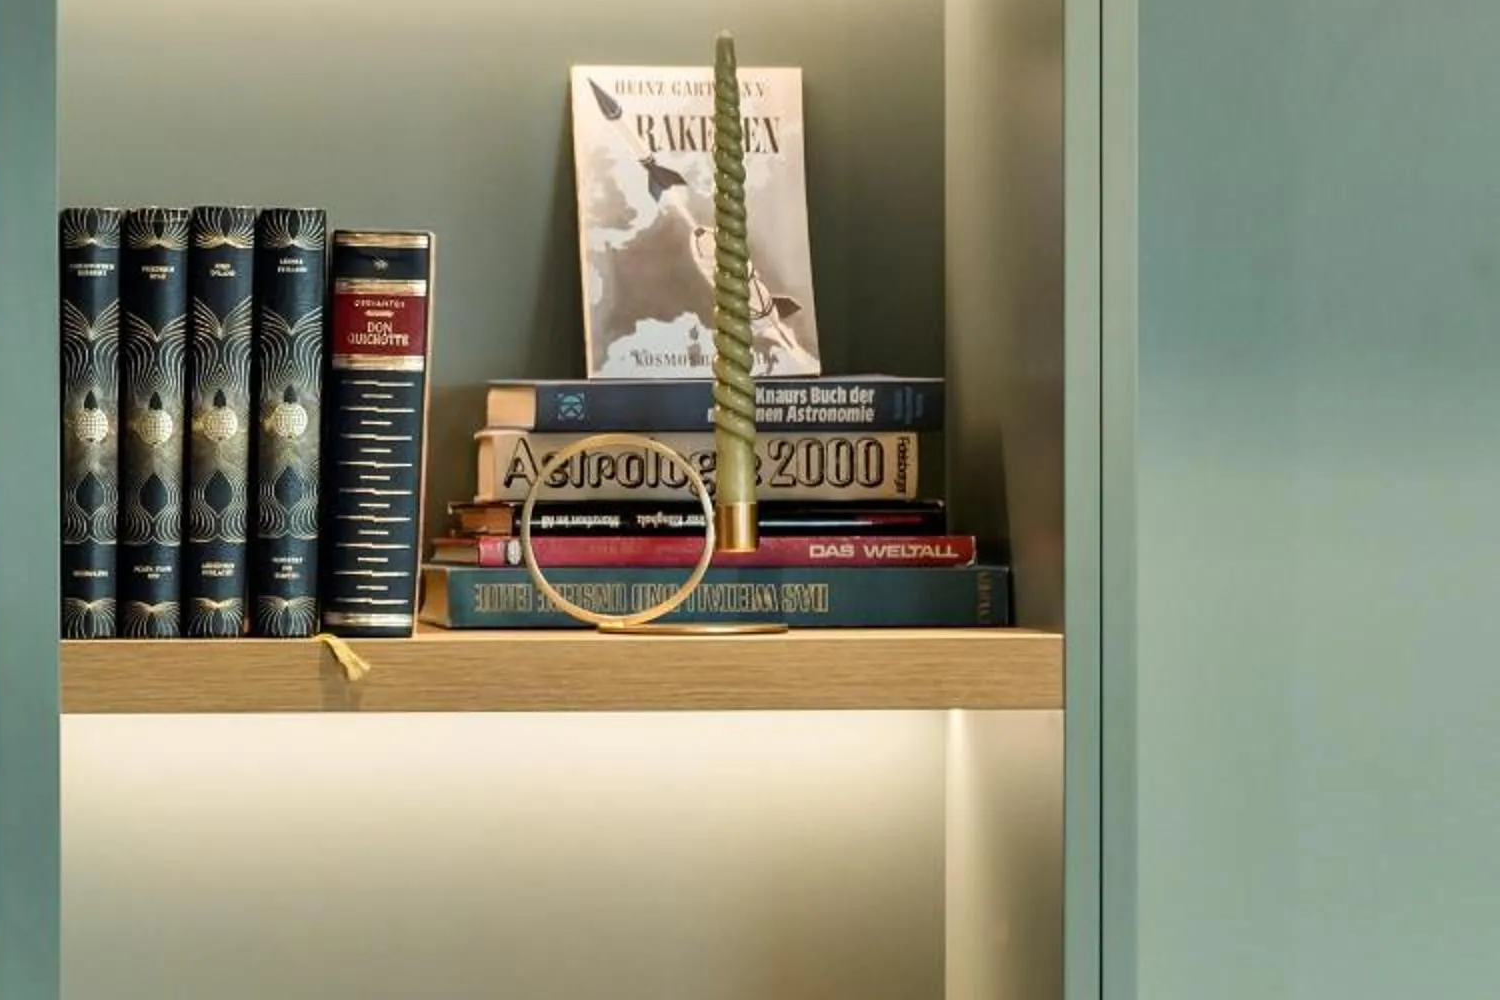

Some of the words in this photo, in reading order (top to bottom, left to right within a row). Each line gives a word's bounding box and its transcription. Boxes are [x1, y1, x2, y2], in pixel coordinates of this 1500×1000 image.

[615, 79, 664, 96] HEINZ
[637, 114, 781, 153] RAKEEN
[367, 321, 393, 334] DON
[347, 332, 410, 346] QUICHOTTE
[756, 386, 807, 405] Knaurs
[811, 385, 847, 404] Buch
[848, 385, 875, 404] der
[786, 406, 875, 423] Astronomie
[767, 436, 885, 488] 2000
[810, 545, 854, 558] DAS
[863, 544, 960, 559] WELTALL
[781, 583, 828, 613] DAS
